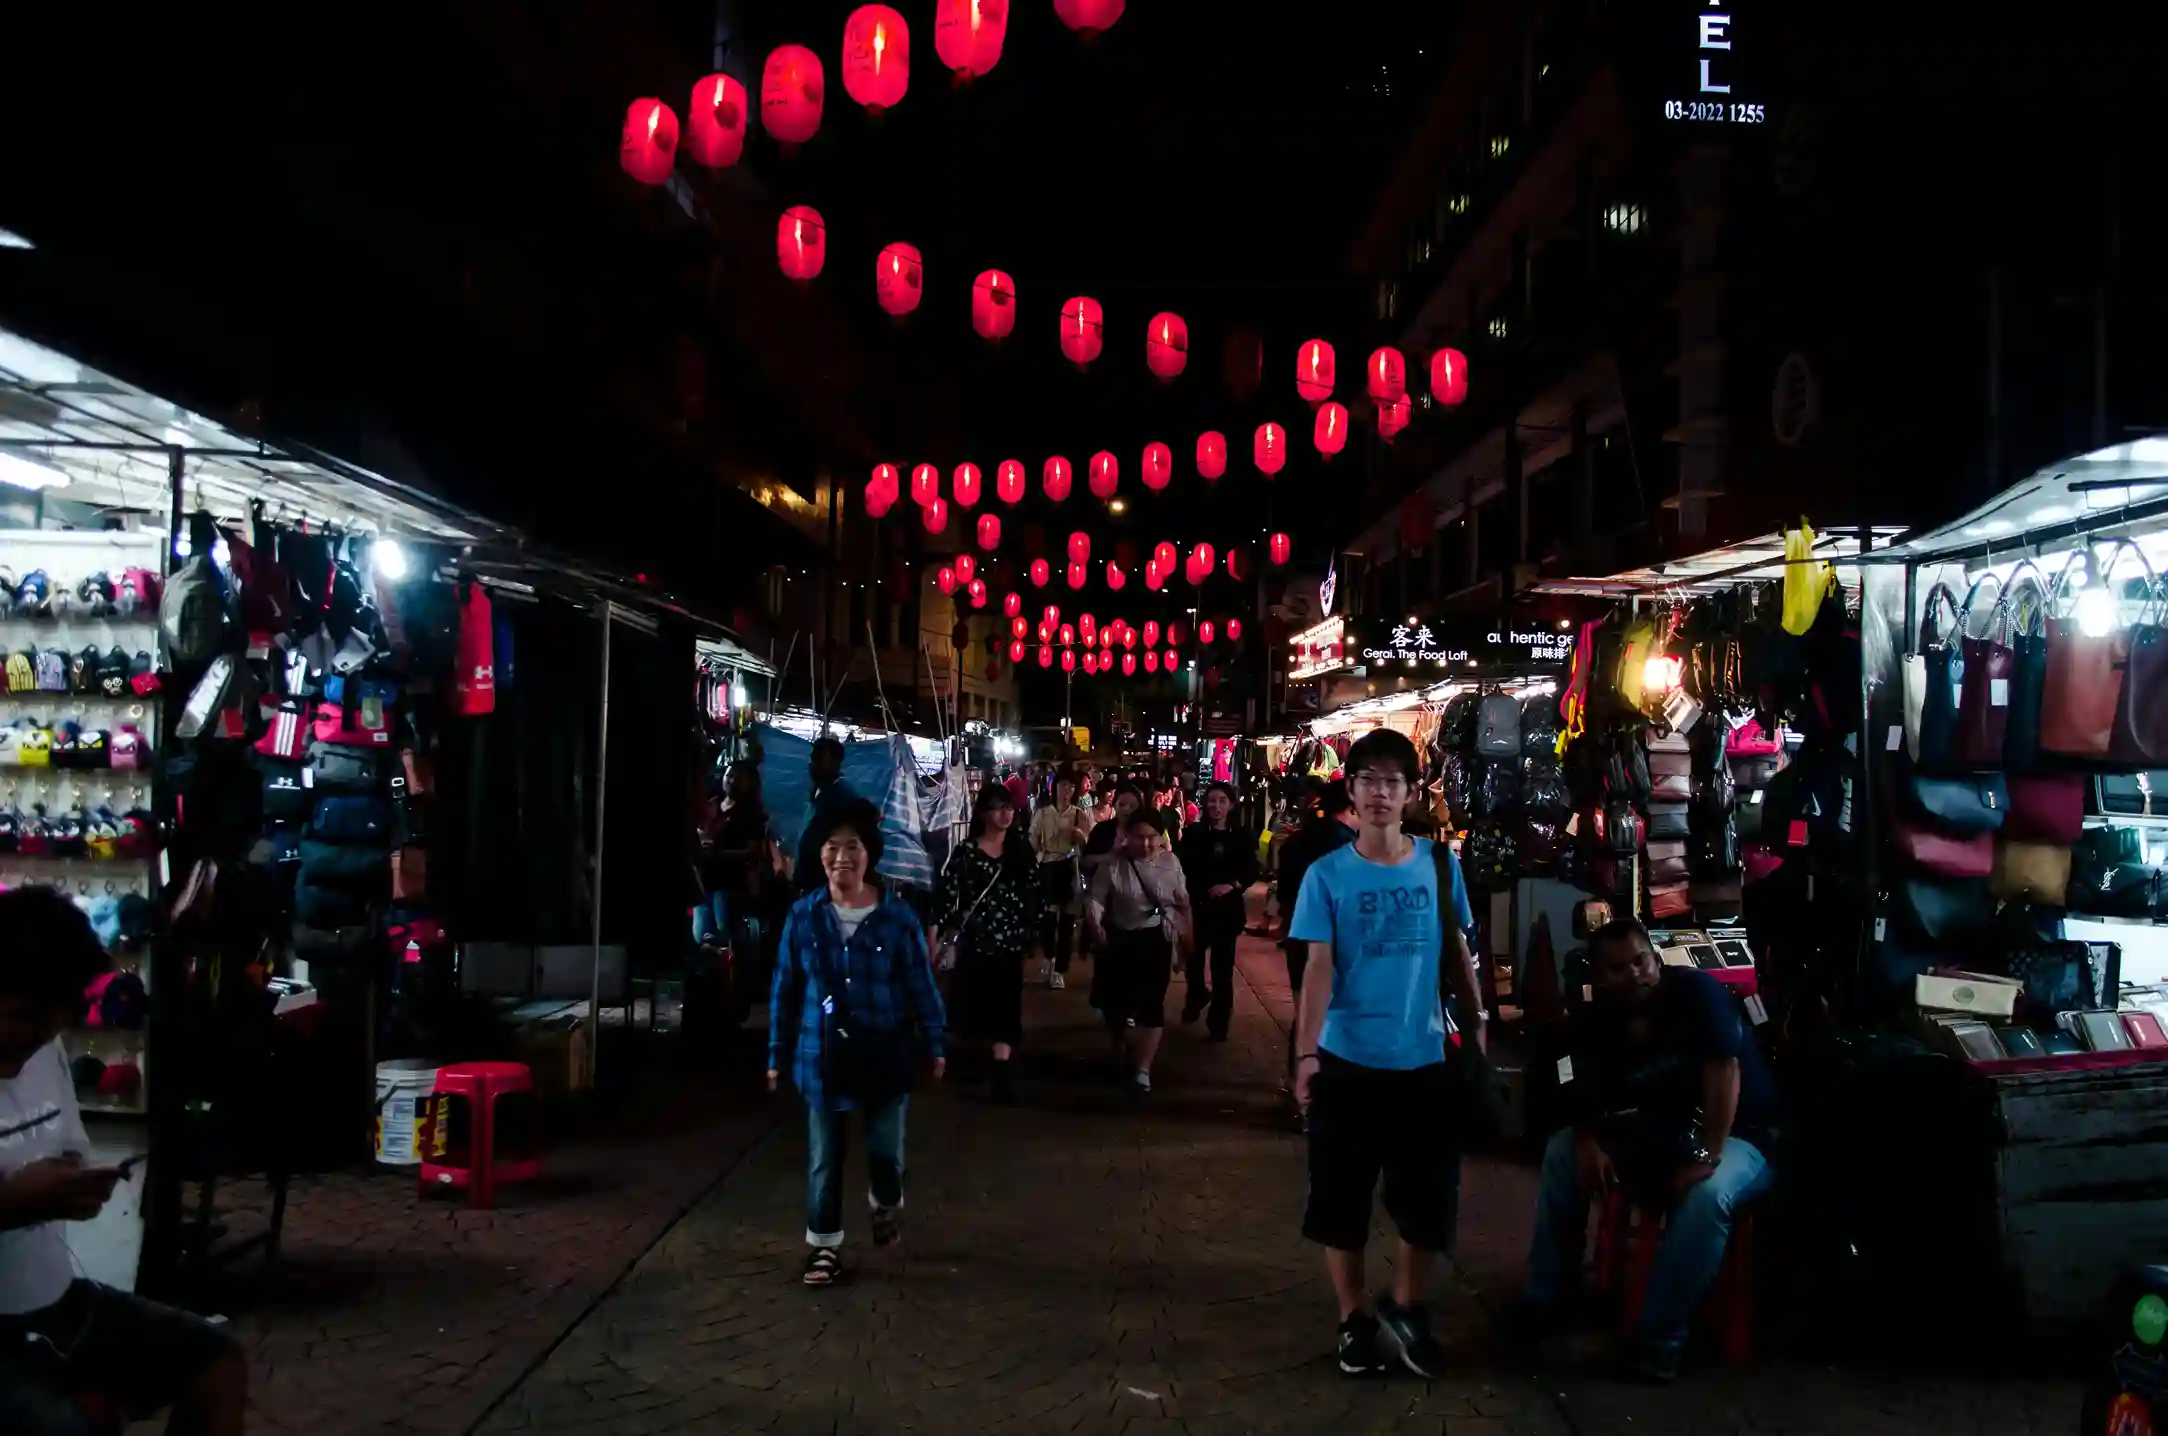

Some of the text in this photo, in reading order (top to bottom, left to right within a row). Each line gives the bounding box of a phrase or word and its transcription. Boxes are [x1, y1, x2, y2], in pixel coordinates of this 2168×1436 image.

[1699, 0, 1731, 93] EL
[1665, 100, 1765, 123] 03-2022 1255
[1389, 624, 1437, 649] 客来
[1363, 648, 1468, 661] Gerai. The Food Loft
[1531, 647, 1569, 659] 原味排
